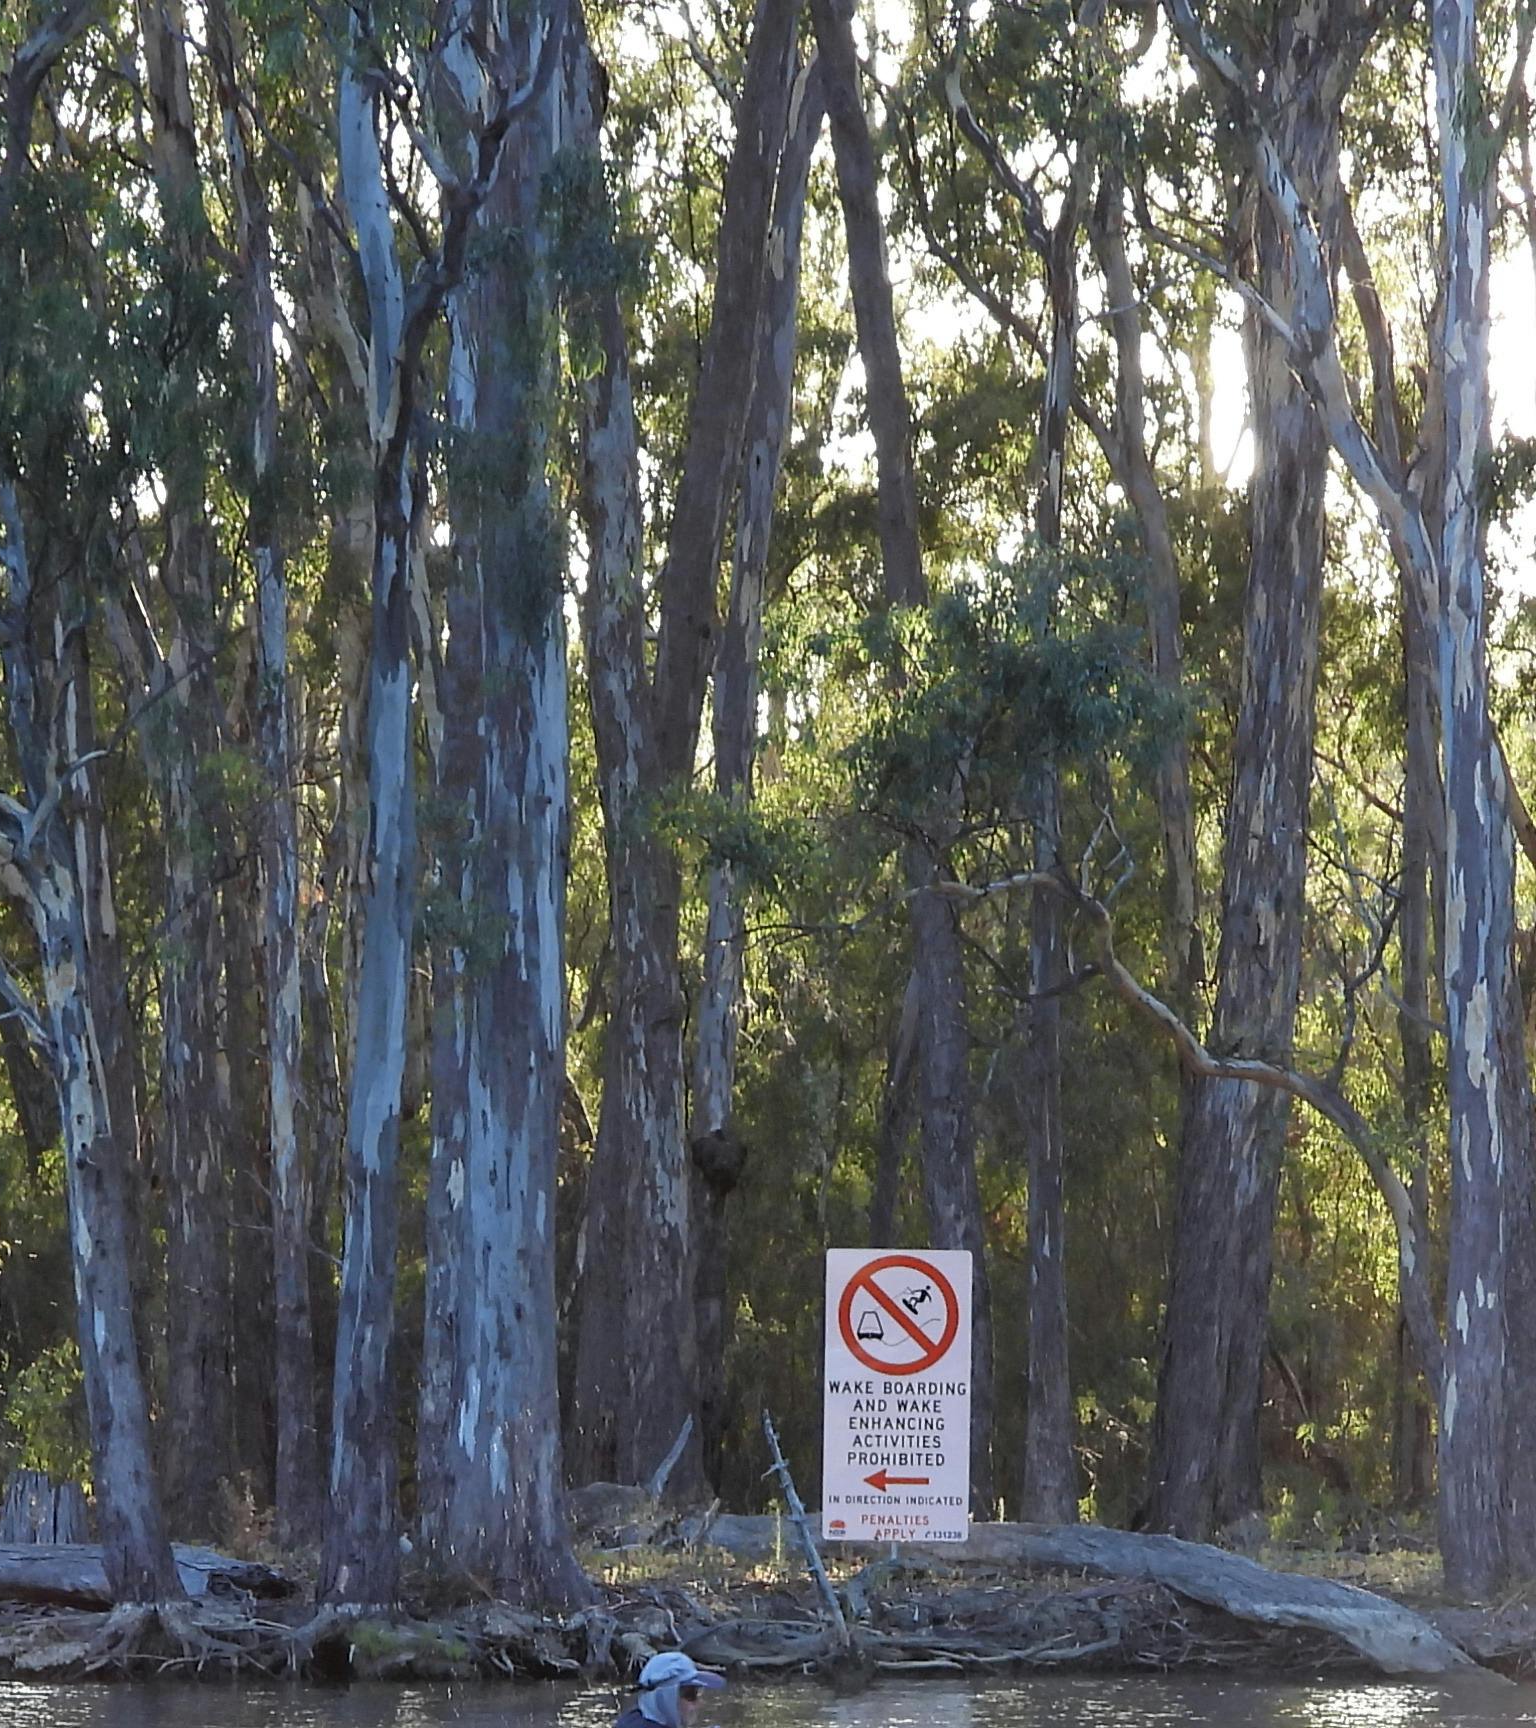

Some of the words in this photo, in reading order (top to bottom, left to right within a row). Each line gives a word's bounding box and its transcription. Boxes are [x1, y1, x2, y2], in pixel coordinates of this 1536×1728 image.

[829, 1381, 874, 1394] WAKE
[884, 1381, 966, 1395] BOARDING
[853, 1399, 887, 1412] AND
[897, 1399, 942, 1413] WAKE
[849, 1416, 945, 1430] ENHANCING
[852, 1434, 941, 1449] ACTIVITIES
[847, 1451, 945, 1466] PROHIBITED
[828, 1495, 840, 1504] IN
[845, 1495, 901, 1505] DIRECTION
[906, 1495, 963, 1506] INDICATED
[861, 1514, 929, 1526] PENALTIES
[874, 1529, 916, 1540] APPLY
